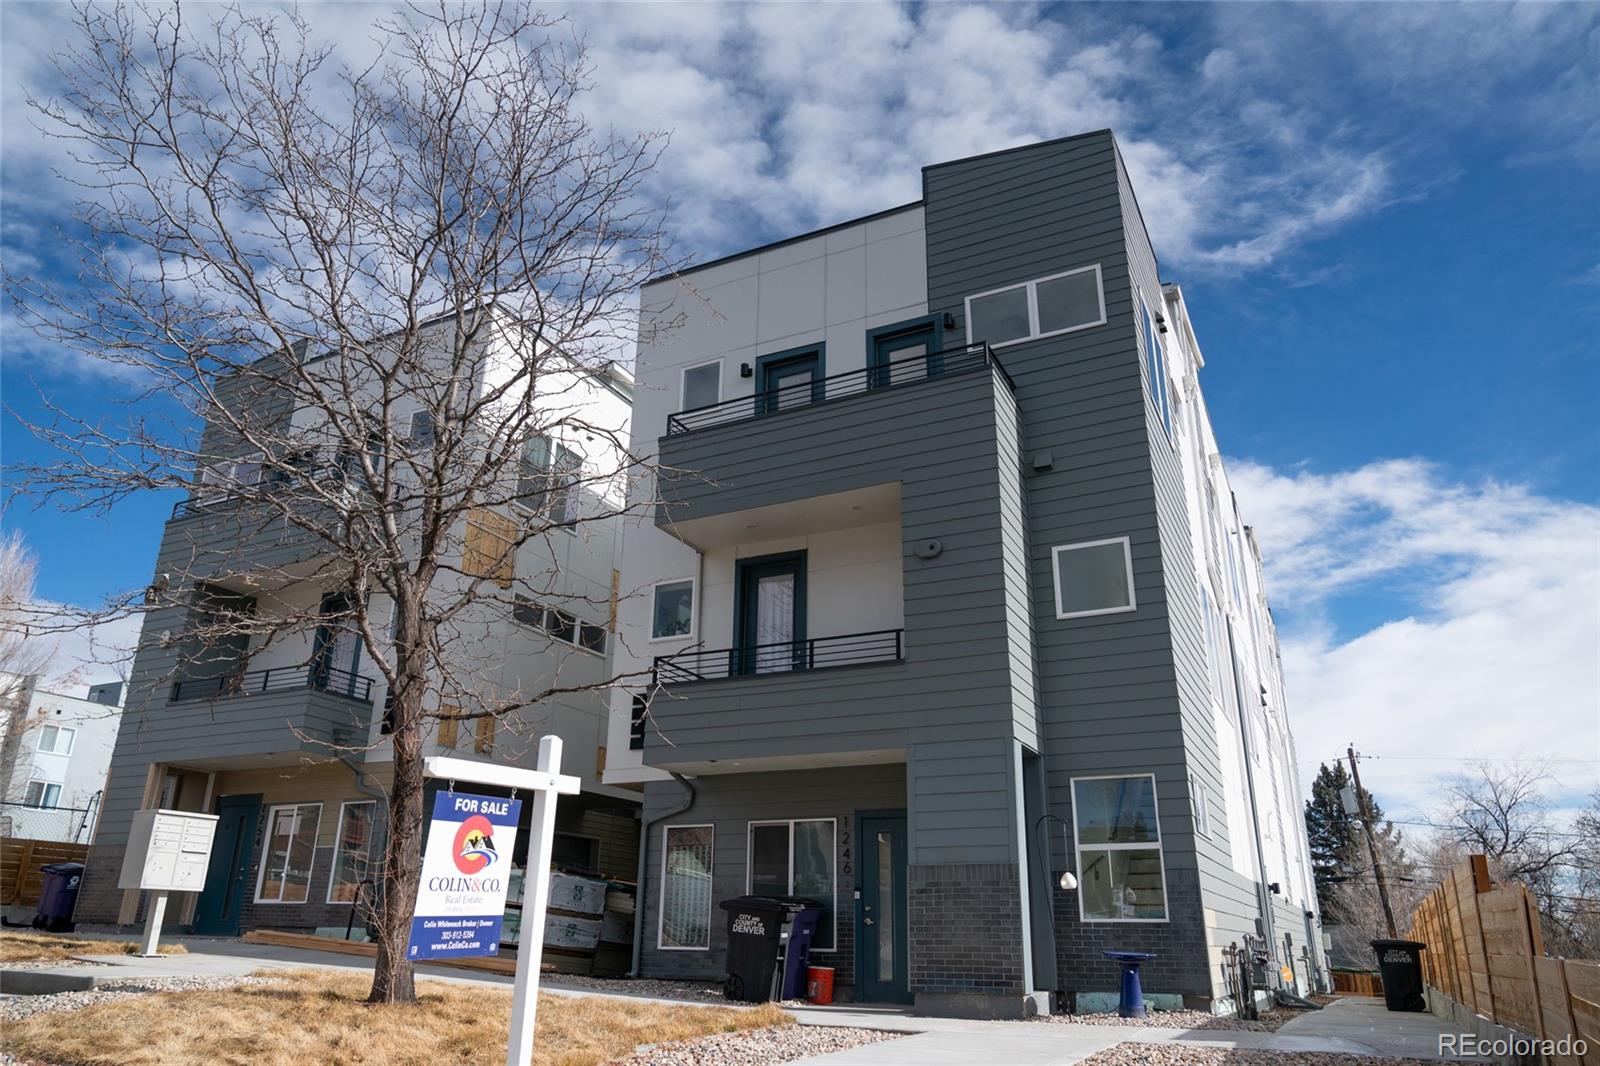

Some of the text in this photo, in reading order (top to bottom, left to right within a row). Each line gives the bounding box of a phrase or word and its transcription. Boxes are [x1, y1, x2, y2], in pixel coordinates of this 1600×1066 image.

[454, 797, 509, 816] FOR SALE
[842, 816, 852, 874] 1246
[429, 876, 501, 893] COLIN&CO.
[445, 894, 484, 905] Real Estate
[732, 924, 764, 935] DENVER
